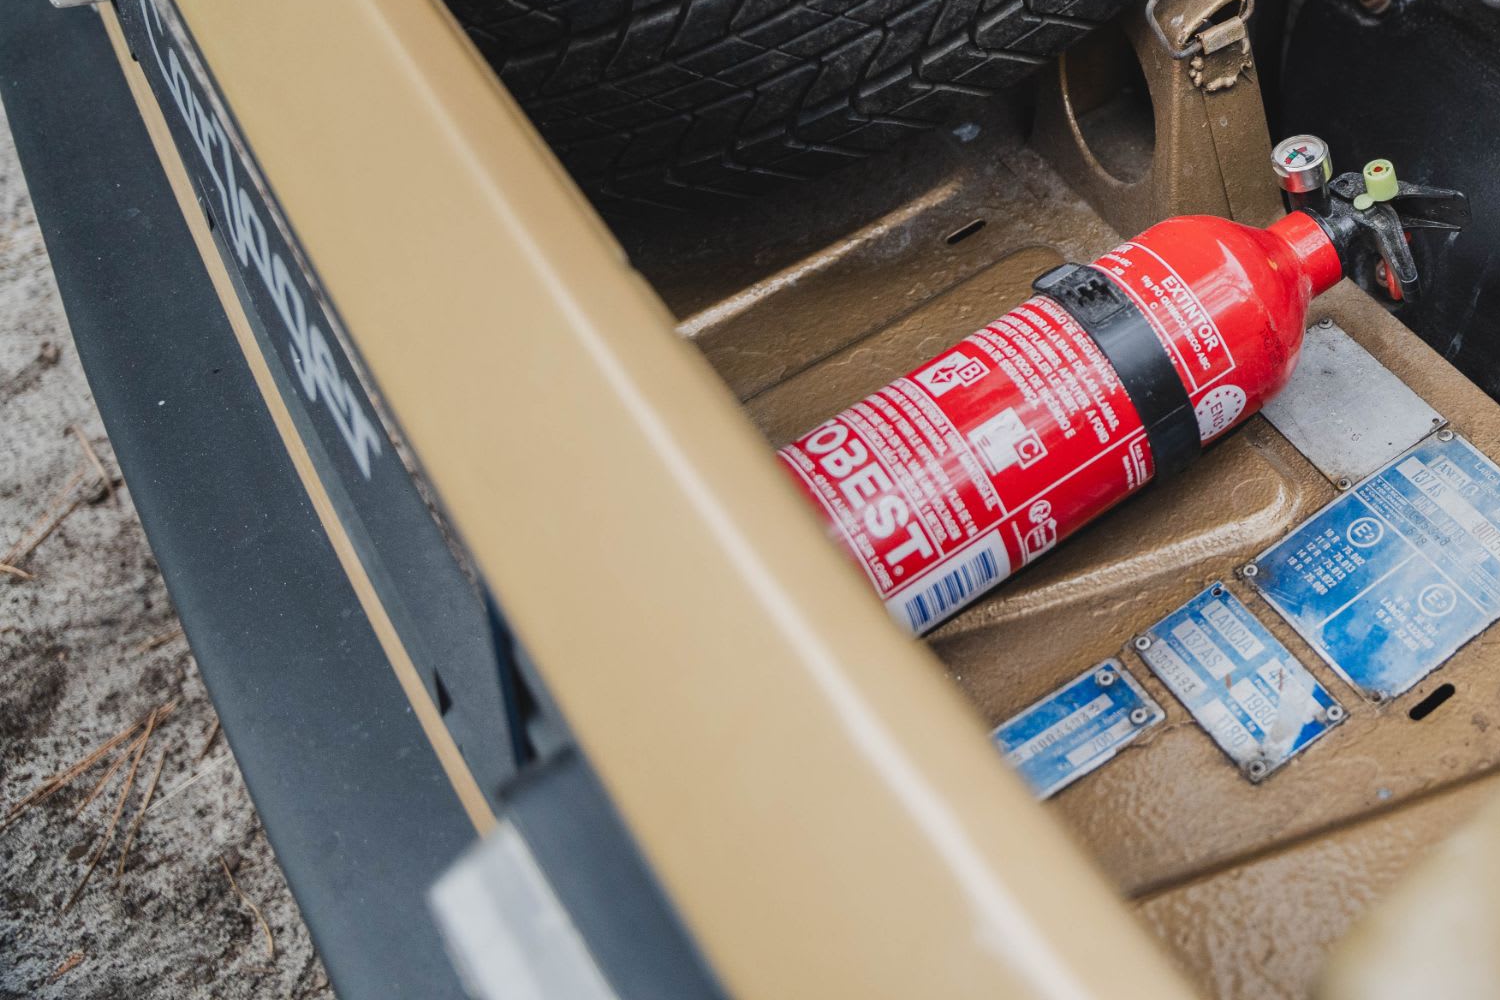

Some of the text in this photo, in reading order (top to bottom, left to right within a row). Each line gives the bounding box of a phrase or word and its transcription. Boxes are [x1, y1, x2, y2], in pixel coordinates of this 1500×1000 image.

[1061, 320, 1078, 335] DE
[1159, 273, 1220, 352] EXTINTOR
[1011, 353, 1034, 378] FOCO
[1027, 373, 1043, 390] DE
[1053, 337, 1078, 362] BASE
[1070, 357, 1088, 376] DE
[1079, 371, 1099, 395] LAS
[1194, 350, 1212, 371] ABC
[1046, 372, 1062, 389] LE
[1207, 400, 1228, 429] EN3
[1206, 604, 1258, 653] LANCIA
[1180, 628, 1223, 669] 137AS
